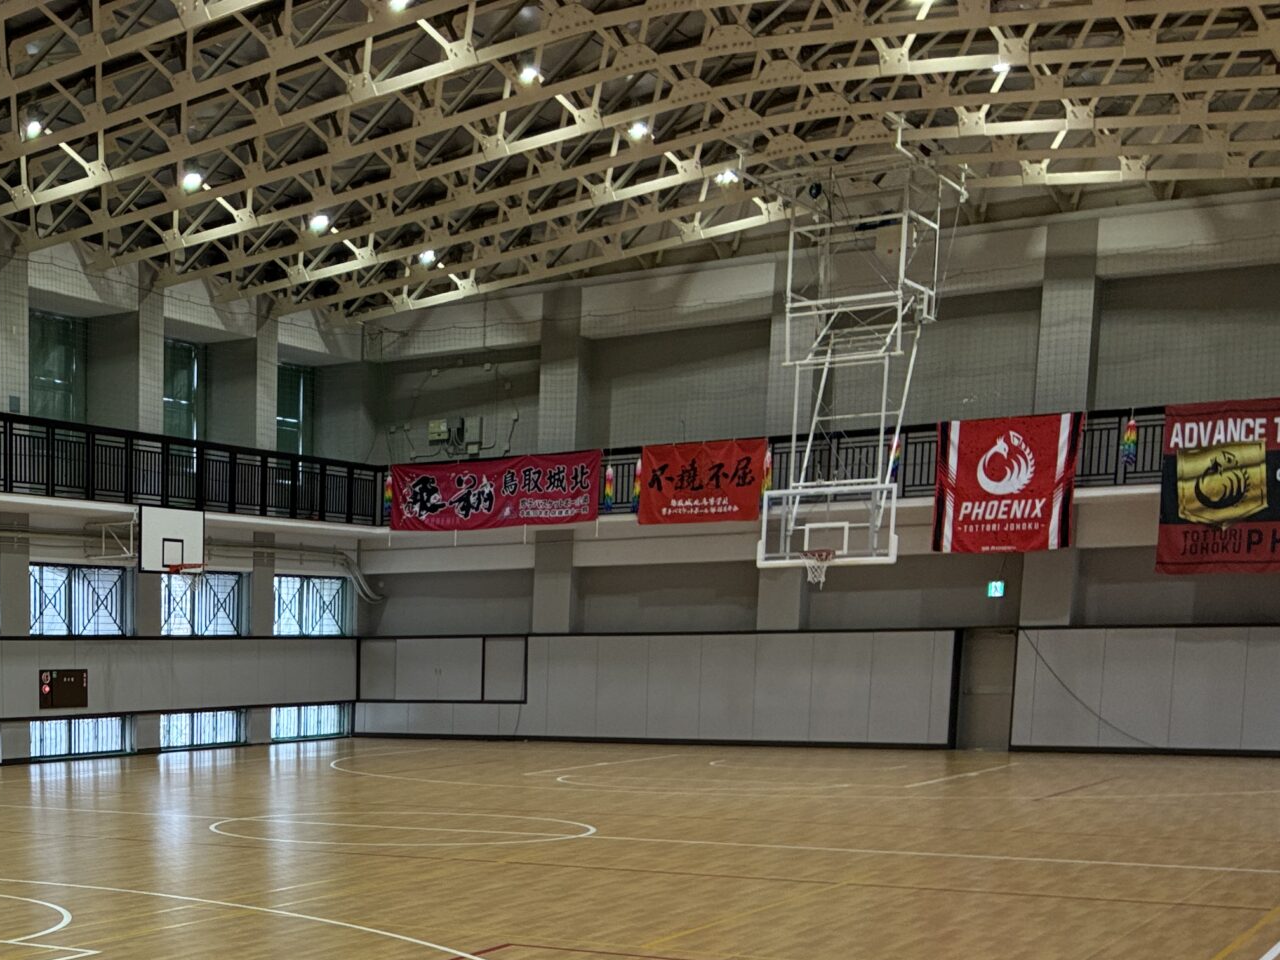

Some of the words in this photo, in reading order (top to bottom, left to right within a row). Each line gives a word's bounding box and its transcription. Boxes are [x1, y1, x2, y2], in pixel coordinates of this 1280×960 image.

[1170, 418, 1267, 449] ADVANCE
[501, 463, 590, 497] 鳥取城北
[958, 498, 1046, 521] PHOENIX
[1181, 540, 1242, 556] JOHOKU
